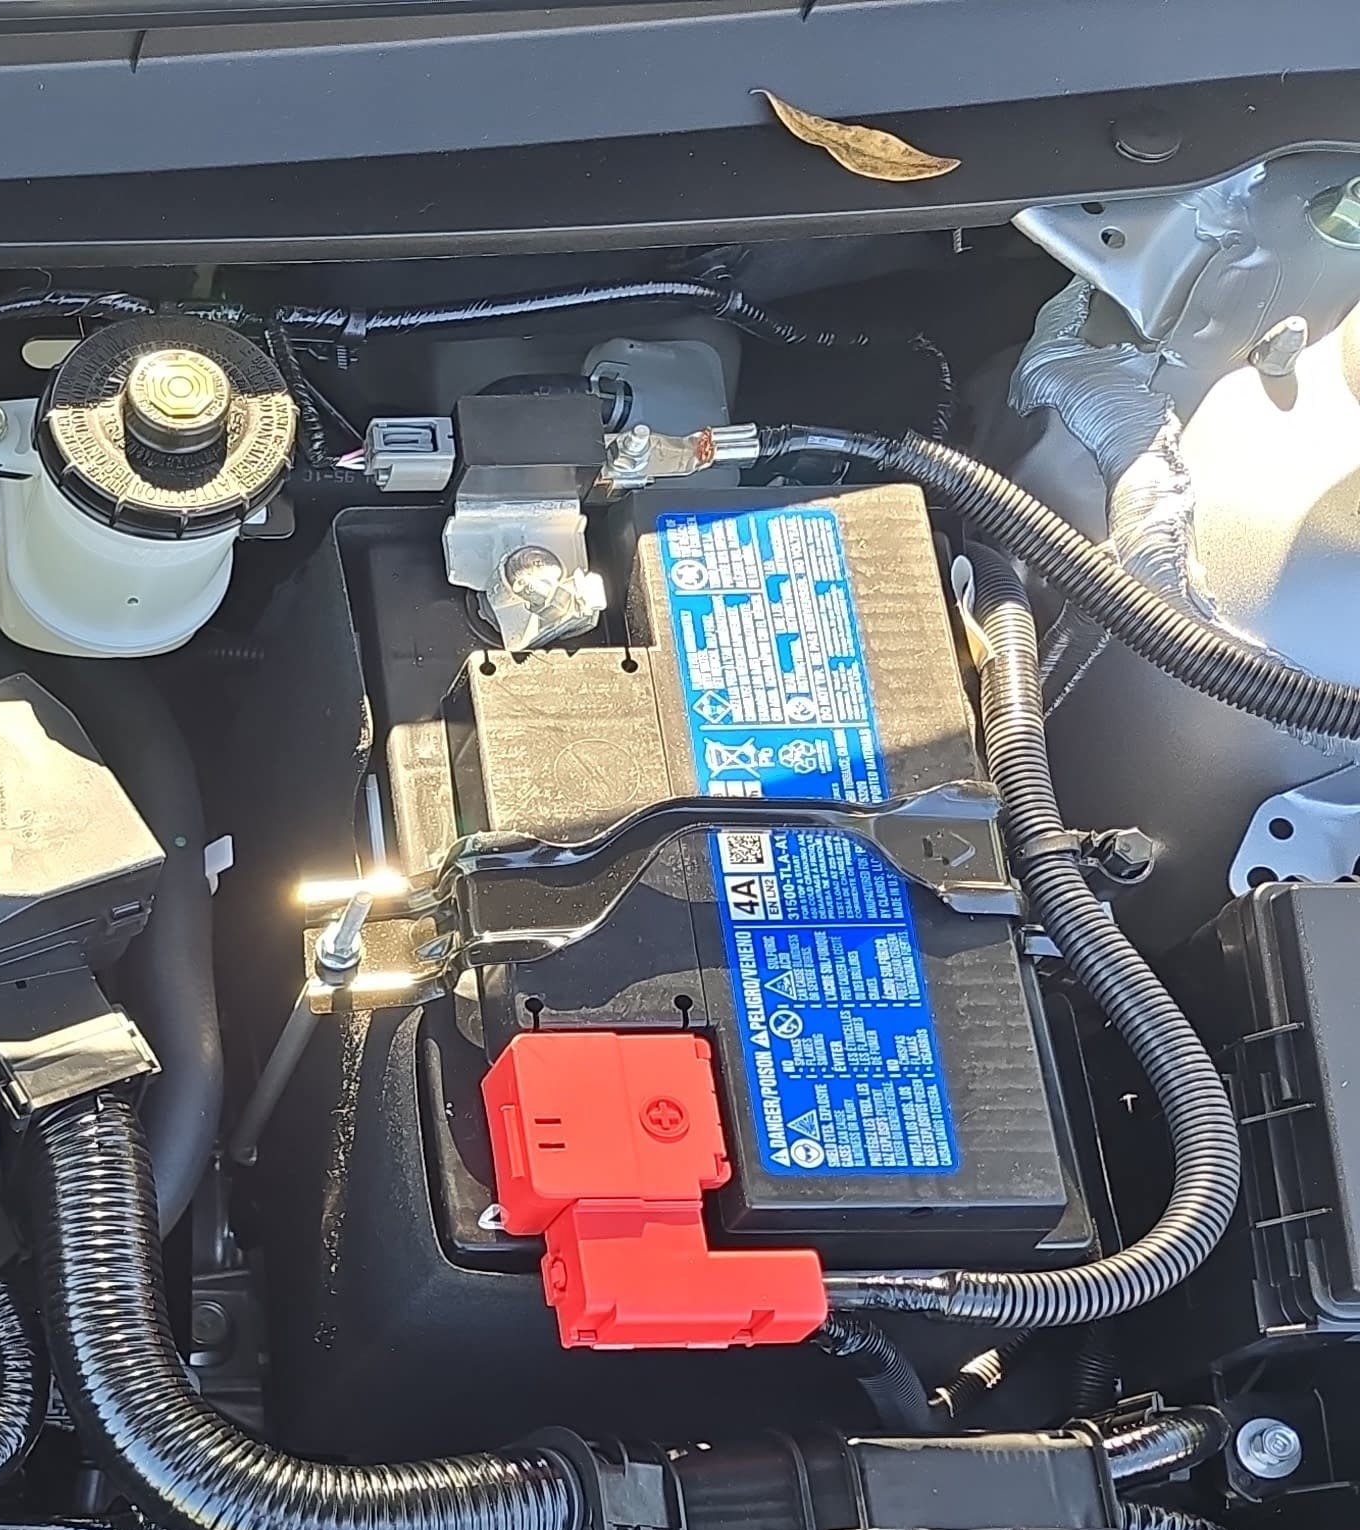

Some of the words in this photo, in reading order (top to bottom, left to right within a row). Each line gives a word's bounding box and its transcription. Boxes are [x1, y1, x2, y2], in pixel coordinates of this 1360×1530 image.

[761, 878, 777, 898] LN2
[773, 835, 800, 919] 31500-TLA-A1
[832, 880, 842, 900] LOAD
[806, 886, 816, 905] COLD
[859, 870, 877, 918] MANUFACTURED
[890, 896, 904, 918] MADE
[835, 901, 845, 918] TEST
[734, 930, 767, 1030] PELIGRO/VENENO
[801, 1036, 817, 1066] FLAMES
[827, 1039, 847, 1071] ÉVITER
[754, 1051, 788, 1147] DANGER/POISON
